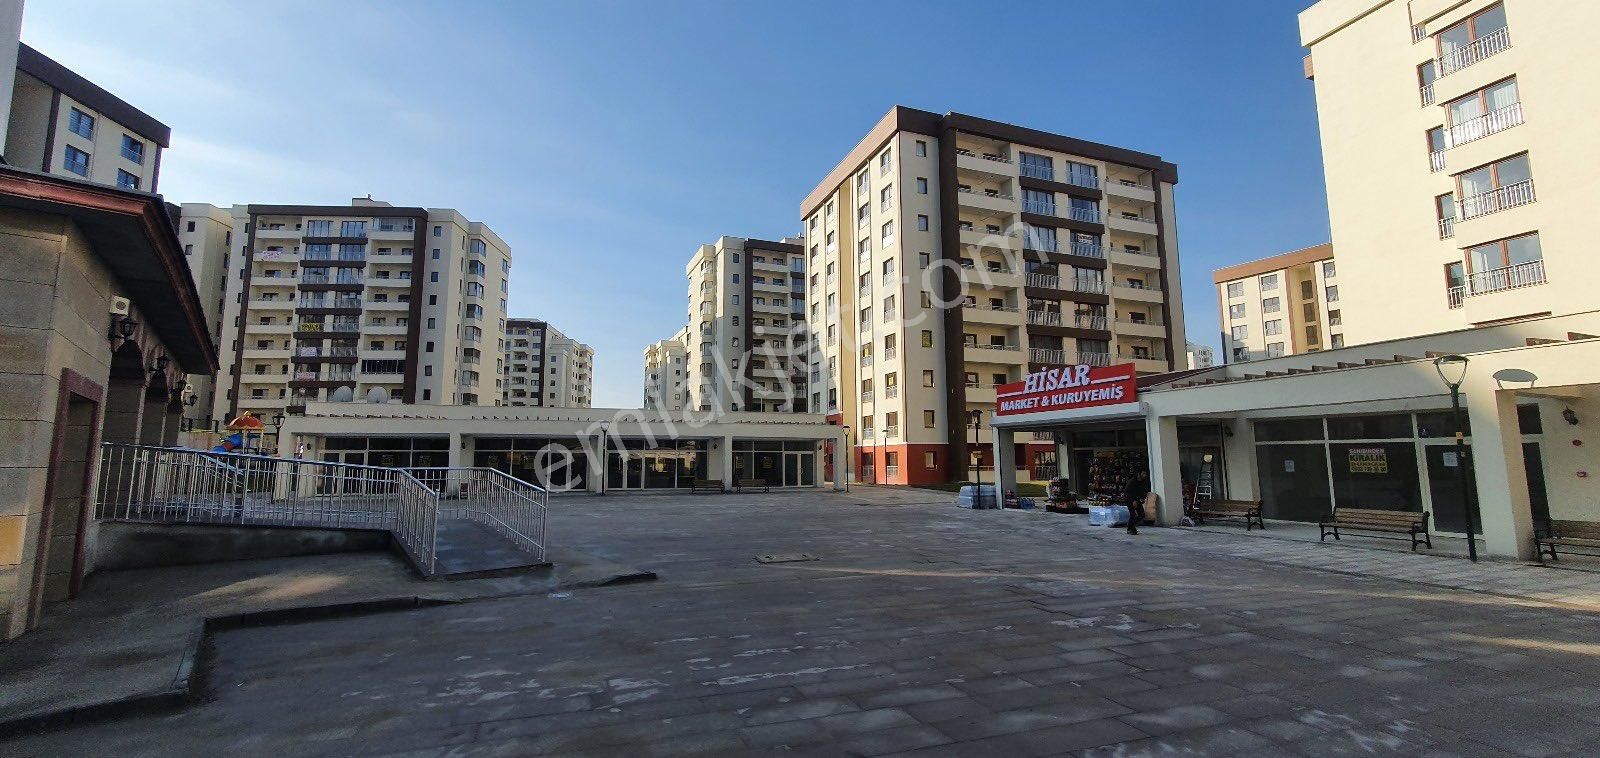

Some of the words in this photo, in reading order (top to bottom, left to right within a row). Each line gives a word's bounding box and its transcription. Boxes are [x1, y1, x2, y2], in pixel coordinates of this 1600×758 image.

[1023, 364, 1091, 394] HİSAR
[1000, 397, 1039, 412] MARKET
[1041, 395, 1050, 407] &
[1051, 383, 1124, 406] KURUYEMİŞ
